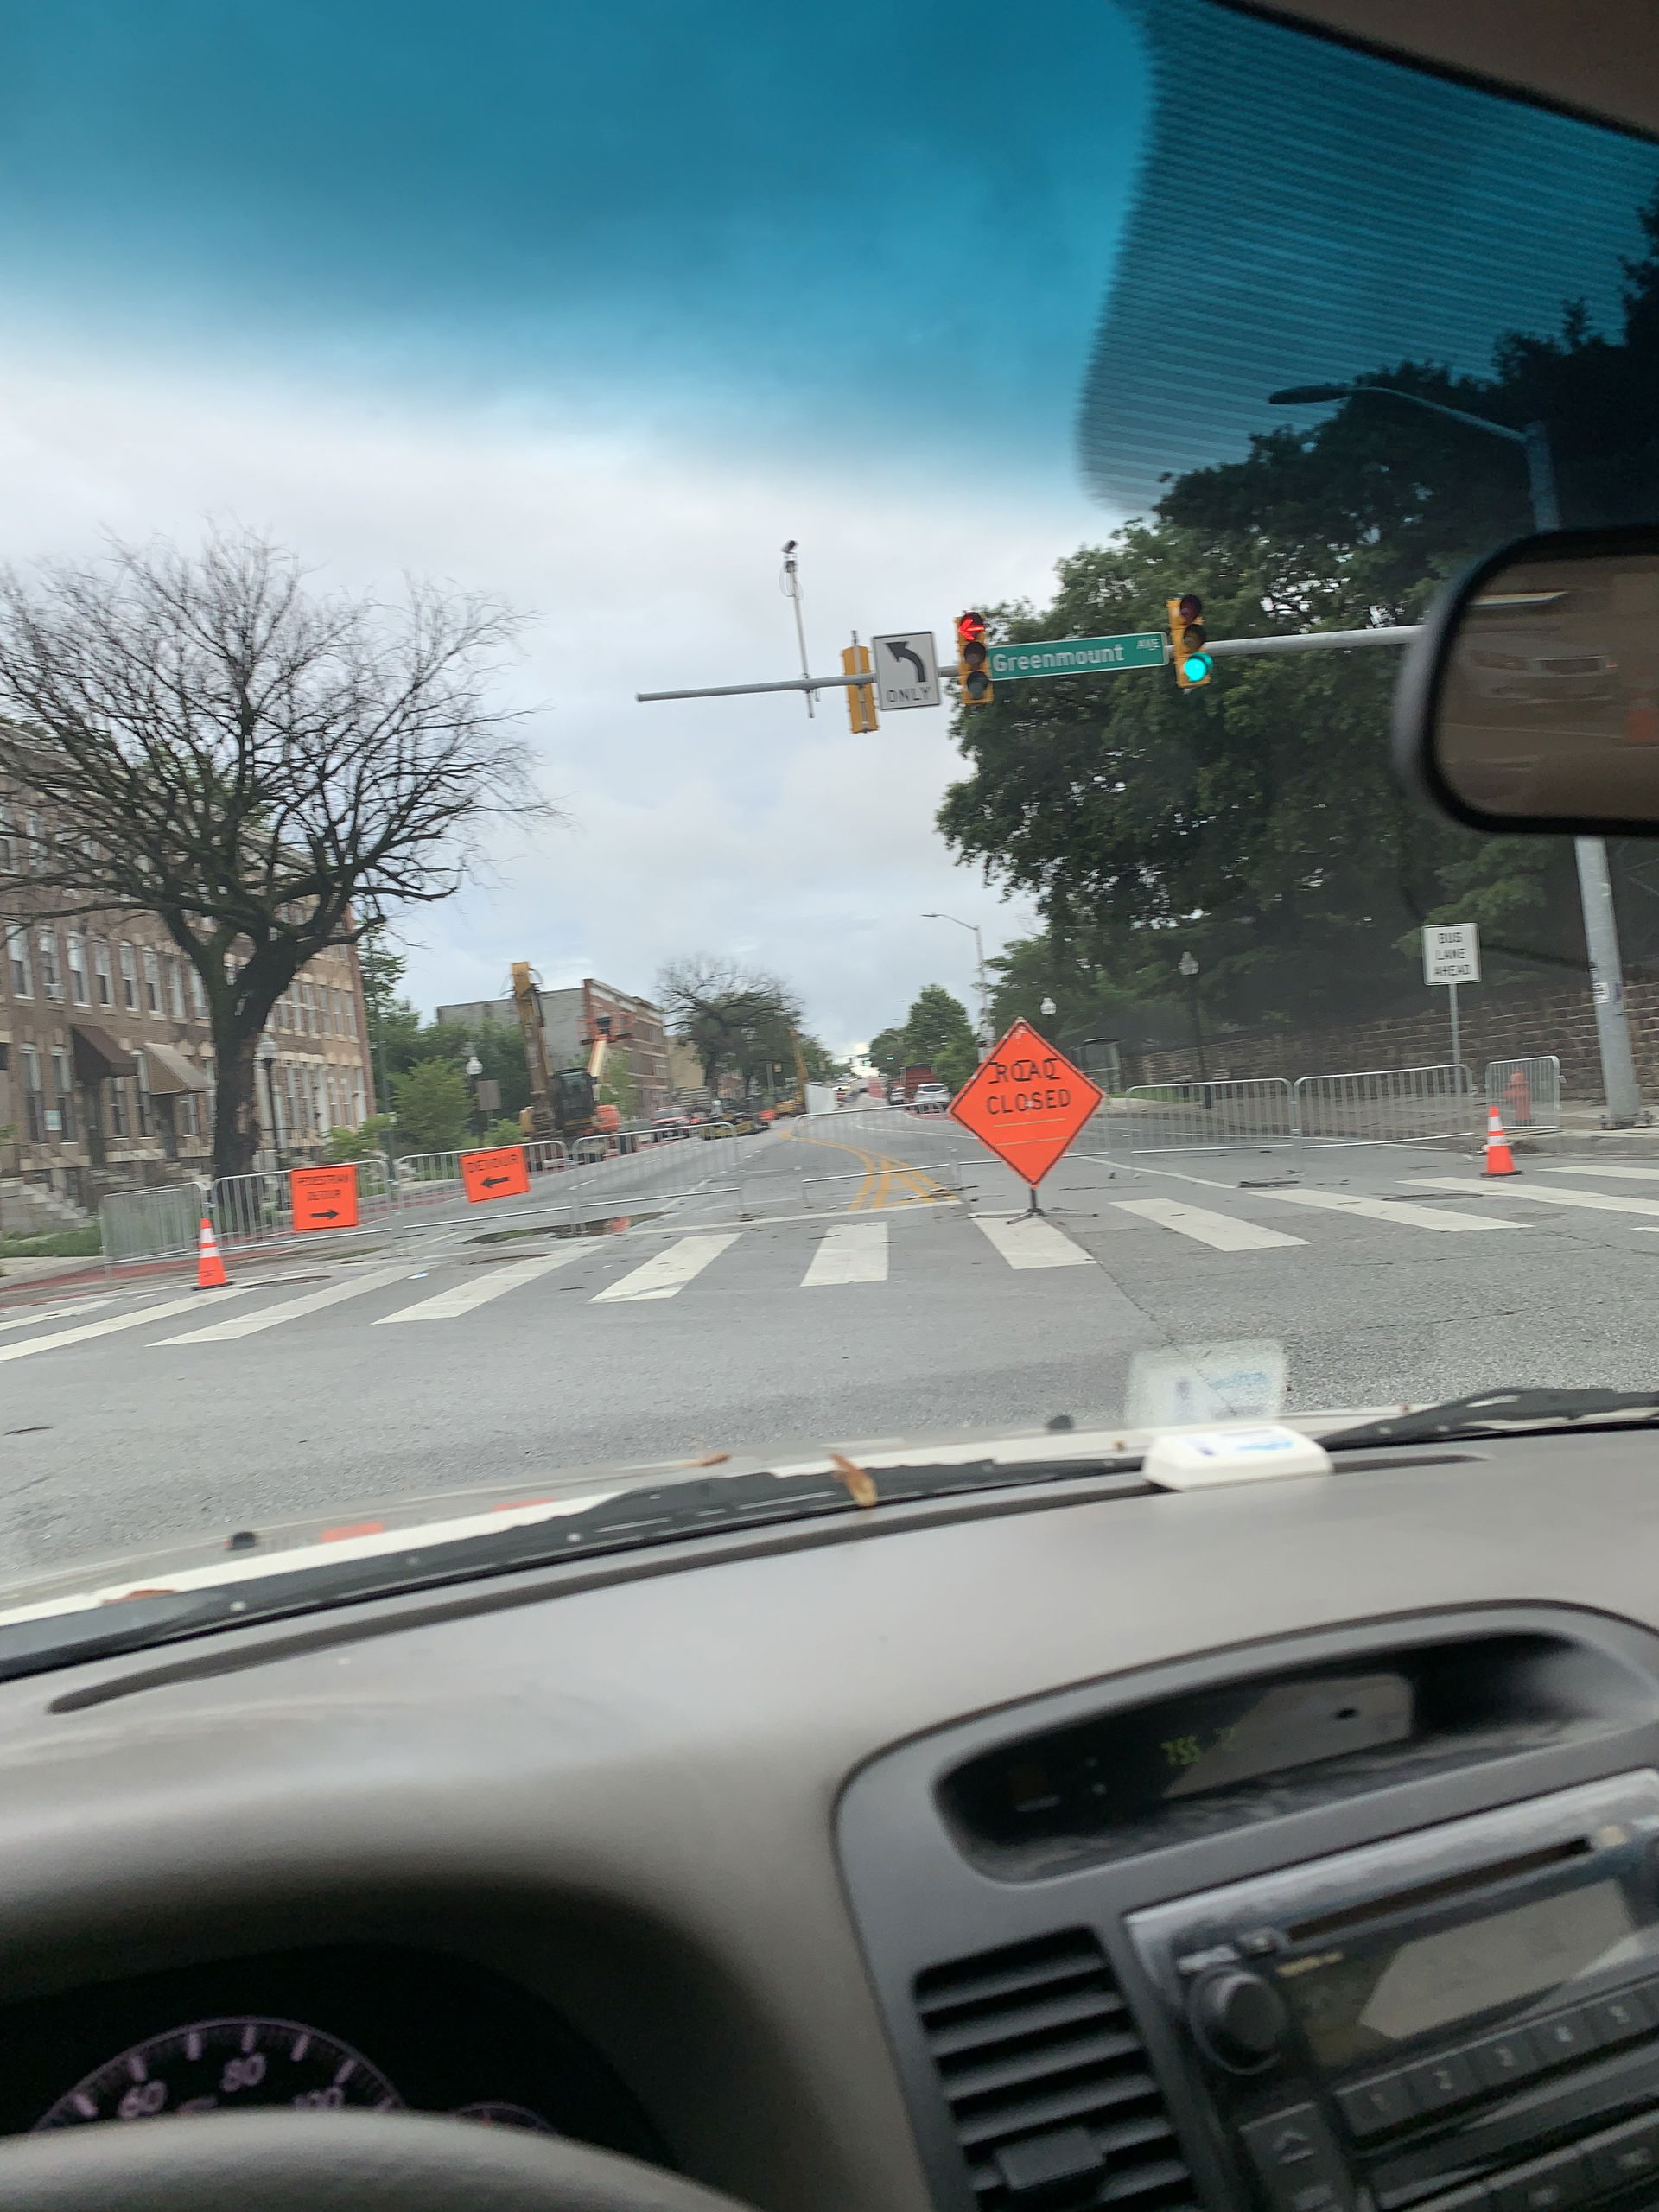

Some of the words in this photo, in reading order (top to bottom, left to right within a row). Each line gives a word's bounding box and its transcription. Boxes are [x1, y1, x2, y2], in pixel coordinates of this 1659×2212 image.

[994, 644, 1125, 672] Greenmount
[1136, 638, 1161, 651] AVE
[886, 686, 931, 702] ONLY
[1437, 932, 1464, 944] BUS
[1434, 948, 1467, 961] LANE
[1433, 964, 1472, 976] AHEAD
[988, 1058, 1061, 1084] ROAD
[986, 1088, 1072, 1116] CLOSED
